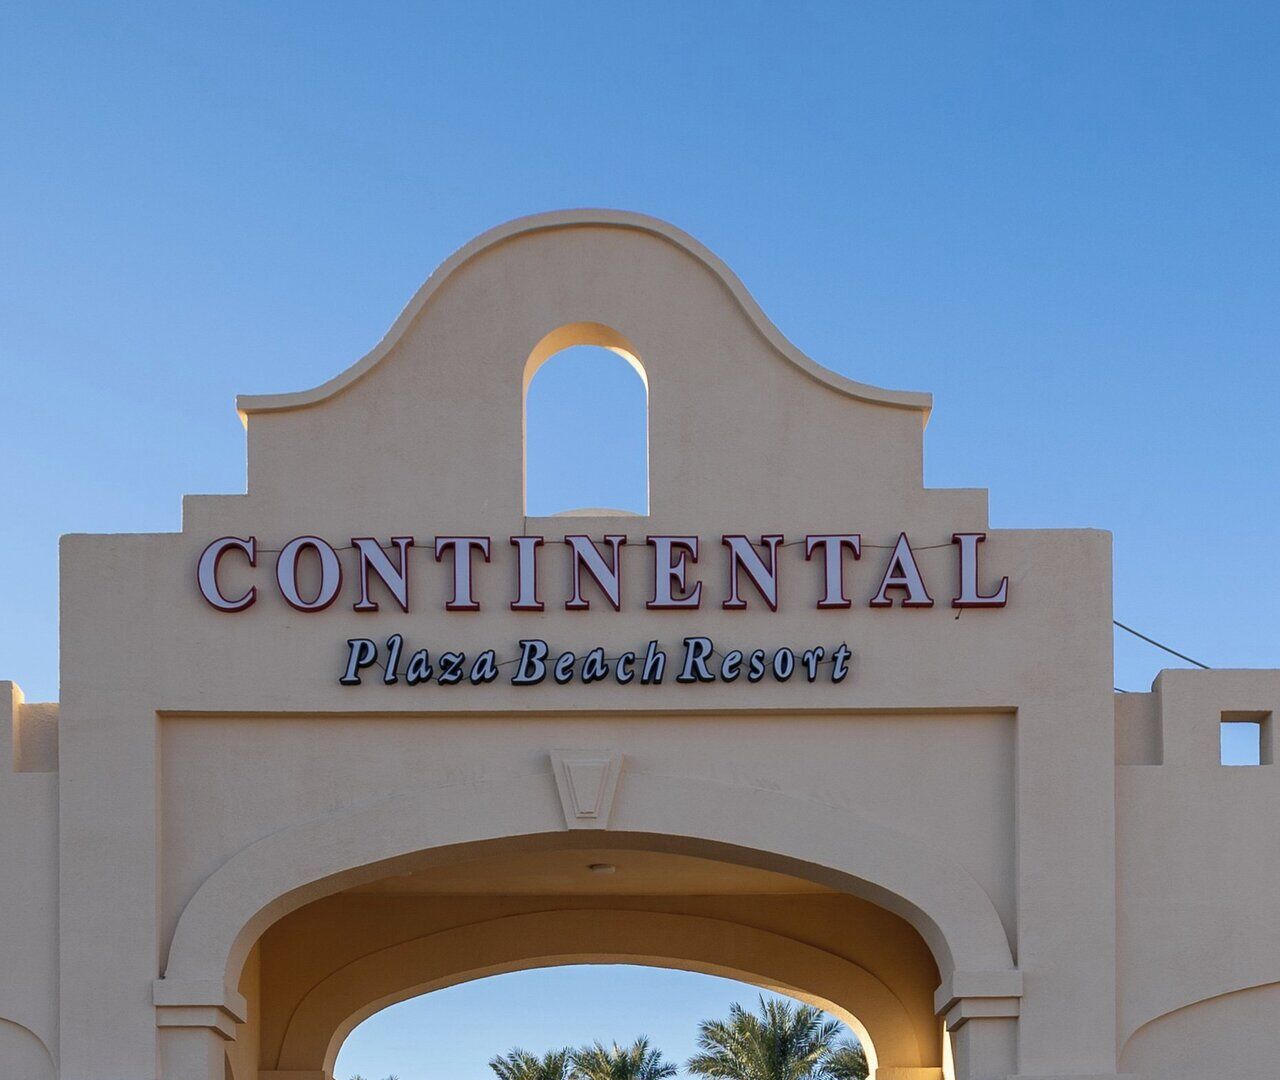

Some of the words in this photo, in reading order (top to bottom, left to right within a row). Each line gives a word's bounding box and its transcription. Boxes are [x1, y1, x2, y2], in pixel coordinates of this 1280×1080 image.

[196, 532, 1009, 613] CONTINENTAL
[339, 633, 499, 687] Plaza
[511, 638, 667, 687] Beach
[674, 636, 852, 685] Resort
